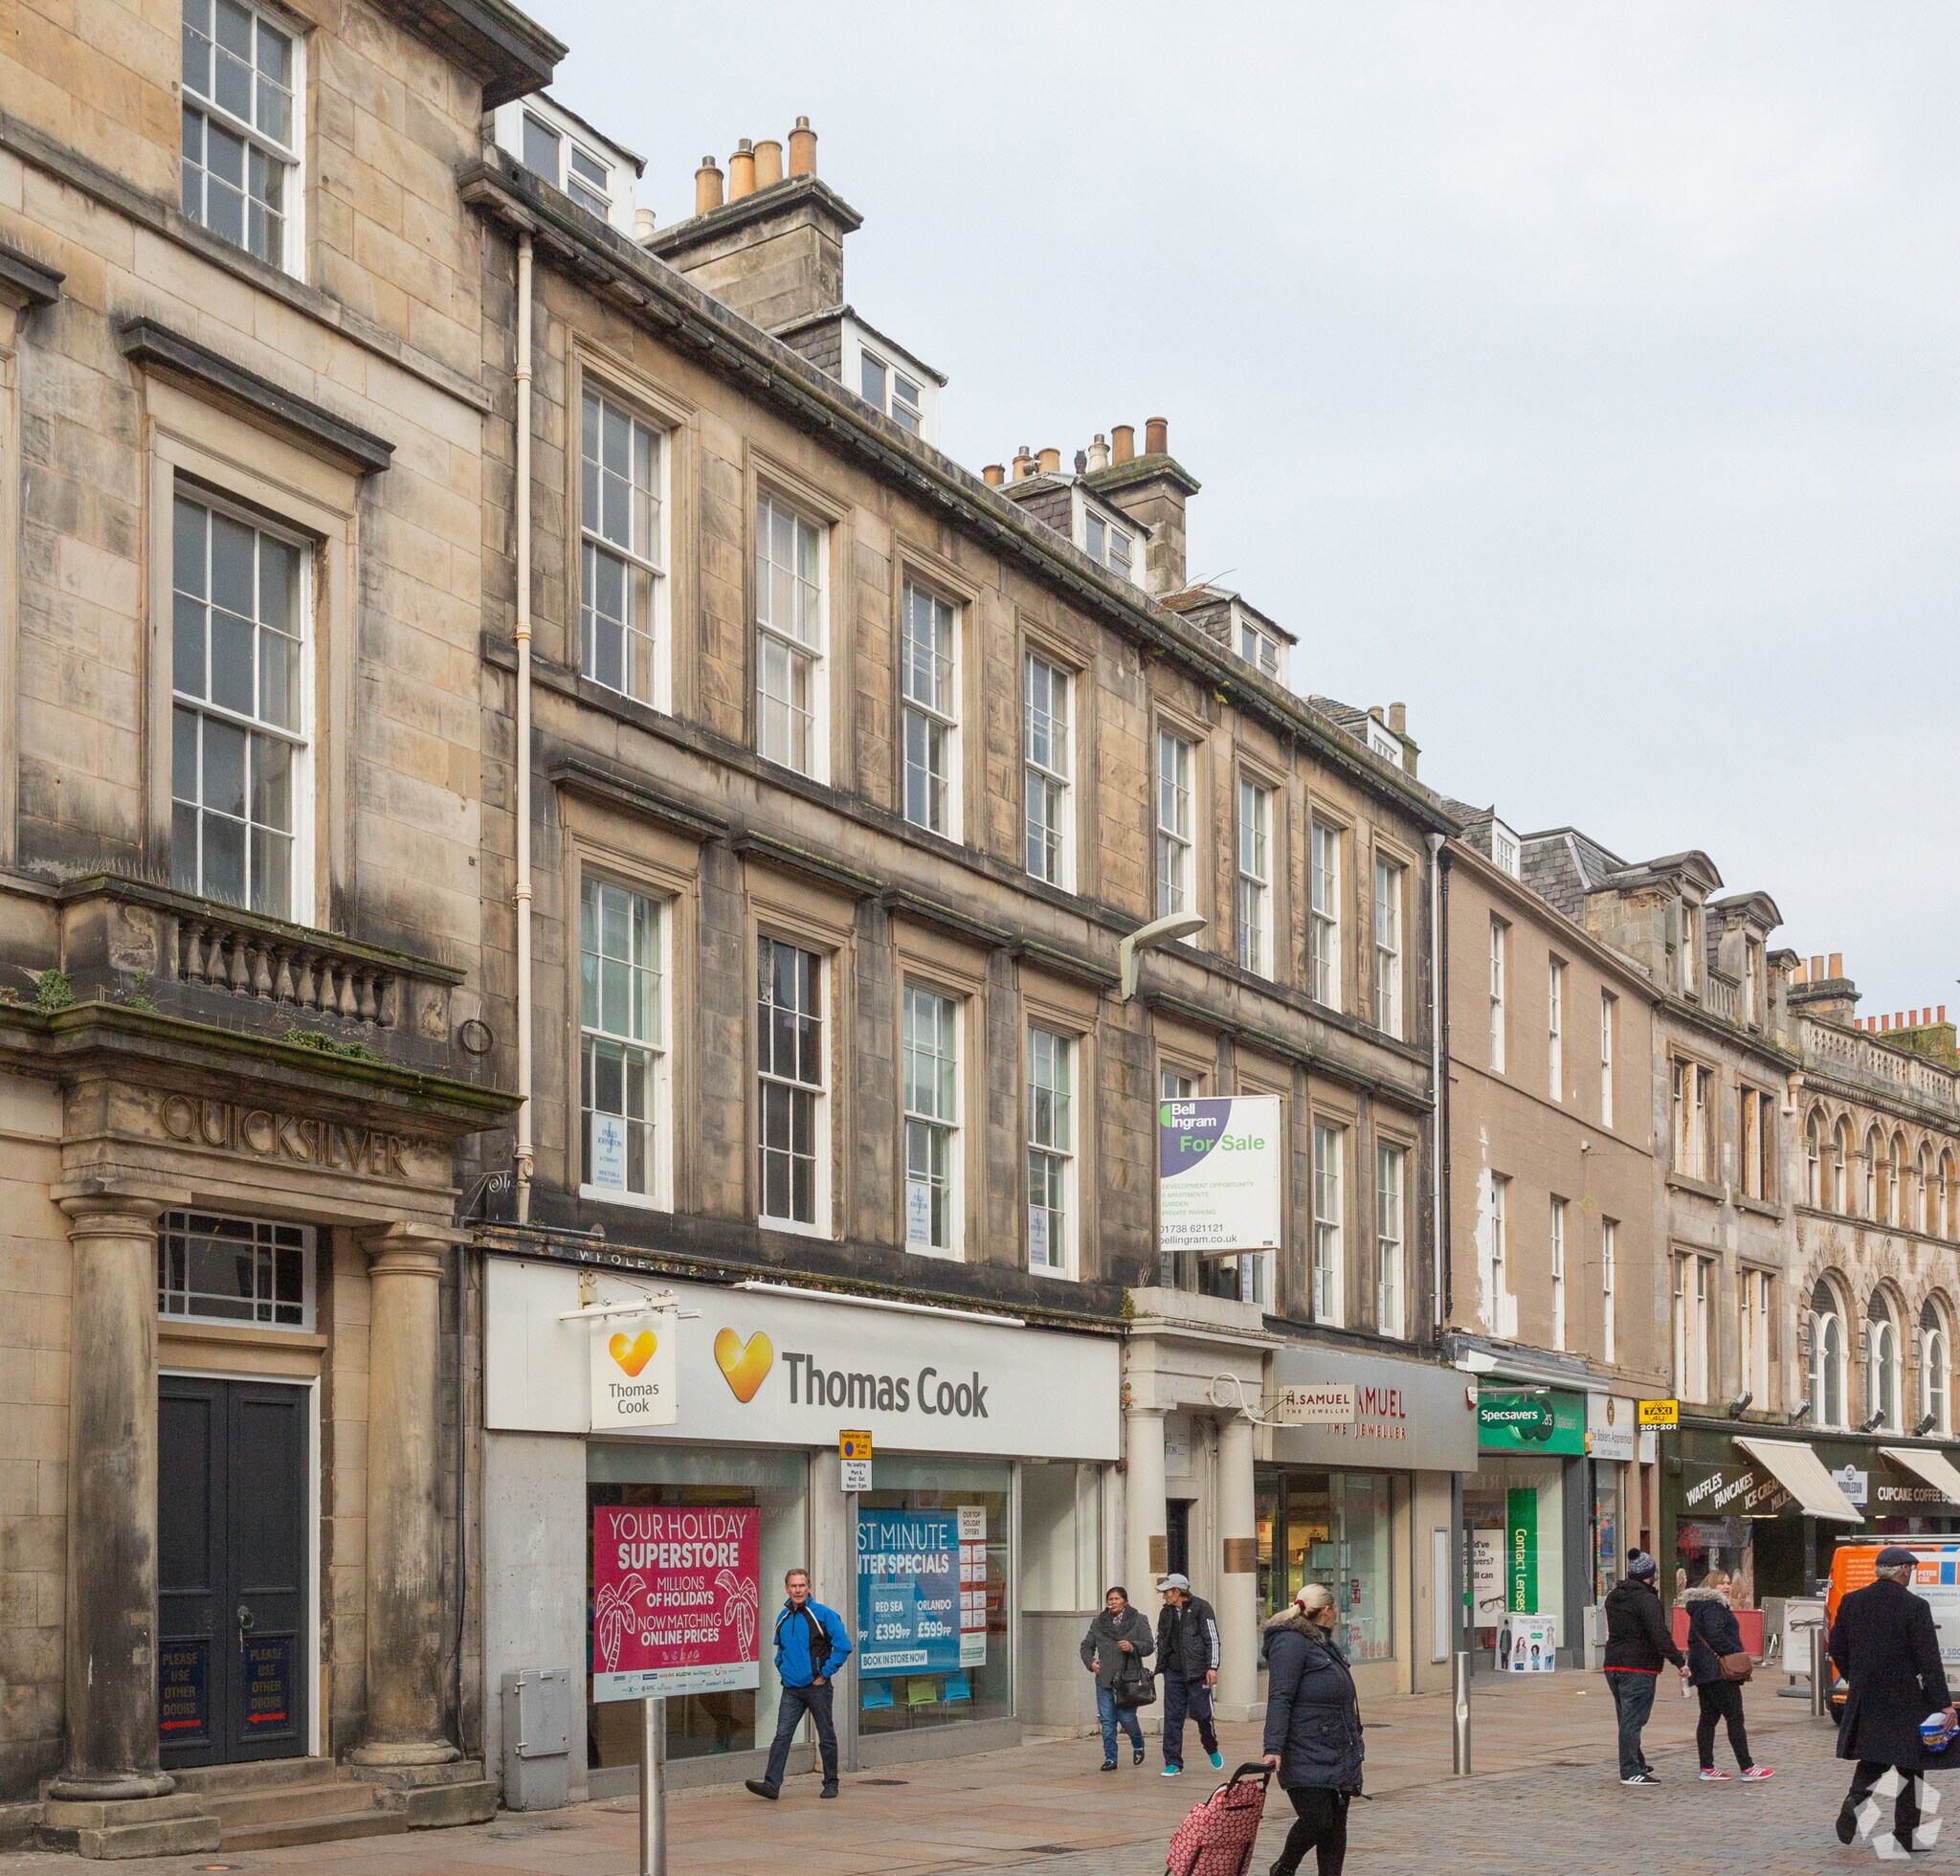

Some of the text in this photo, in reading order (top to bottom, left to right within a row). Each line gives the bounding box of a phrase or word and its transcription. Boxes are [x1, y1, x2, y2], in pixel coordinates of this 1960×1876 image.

[1171, 1103, 1196, 1115] Bell
[1171, 1116, 1217, 1129] Ingram
[158, 1094, 410, 1176] QUICKSILVER
[1179, 1134, 1265, 1152] For Sale
[1191, 1224, 1223, 1233] 621121
[609, 1383, 659, 1397] Thomas
[782, 1351, 990, 1418] Thomas Cook
[617, 1398, 650, 1414] Cook
[1481, 1410, 1538, 1422] Specsavers
[1326, 1423, 1406, 1440] THE JEWELLER
[1685, 1472, 1722, 1507] WAFFLES
[1714, 1472, 1753, 1509] PANCAKES
[1877, 1486, 1913, 1501] CUPCAKE
[1913, 1488, 1941, 1502] COFFEE
[1744, 1489, 1758, 1510] ICE
[610, 1513, 746, 1540] YOUR HOLIDAY
[881, 1523, 948, 1552] MINUTE
[618, 1543, 739, 1569] SUPERSTORE
[888, 1553, 949, 1574] SPECIALS
[1515, 1528, 1527, 1612] Contact Lenses
[657, 1575, 705, 1592] MILLIONS
[646, 1591, 714, 1607] OF HOLIDAYS
[875, 1600, 903, 1613] RED SEA
[918, 1599, 952, 1612] ORLANDO
[637, 1613, 722, 1630] NOW MATCHING
[641, 1630, 682, 1646] ONLINE
[163, 1652, 197, 1665] PLEASE
[251, 1648, 282, 1661] PLEASE
[863, 1652, 925, 1666] BOOK IN STORE NOW
[170, 1669, 189, 1682] USE
[257, 1664, 275, 1677] USE
[165, 1686, 196, 1699] OTHER
[252, 1680, 281, 1692] OTHER
[164, 1703, 196, 1715] DOORS
[252, 1696, 282, 1709] DOORS
